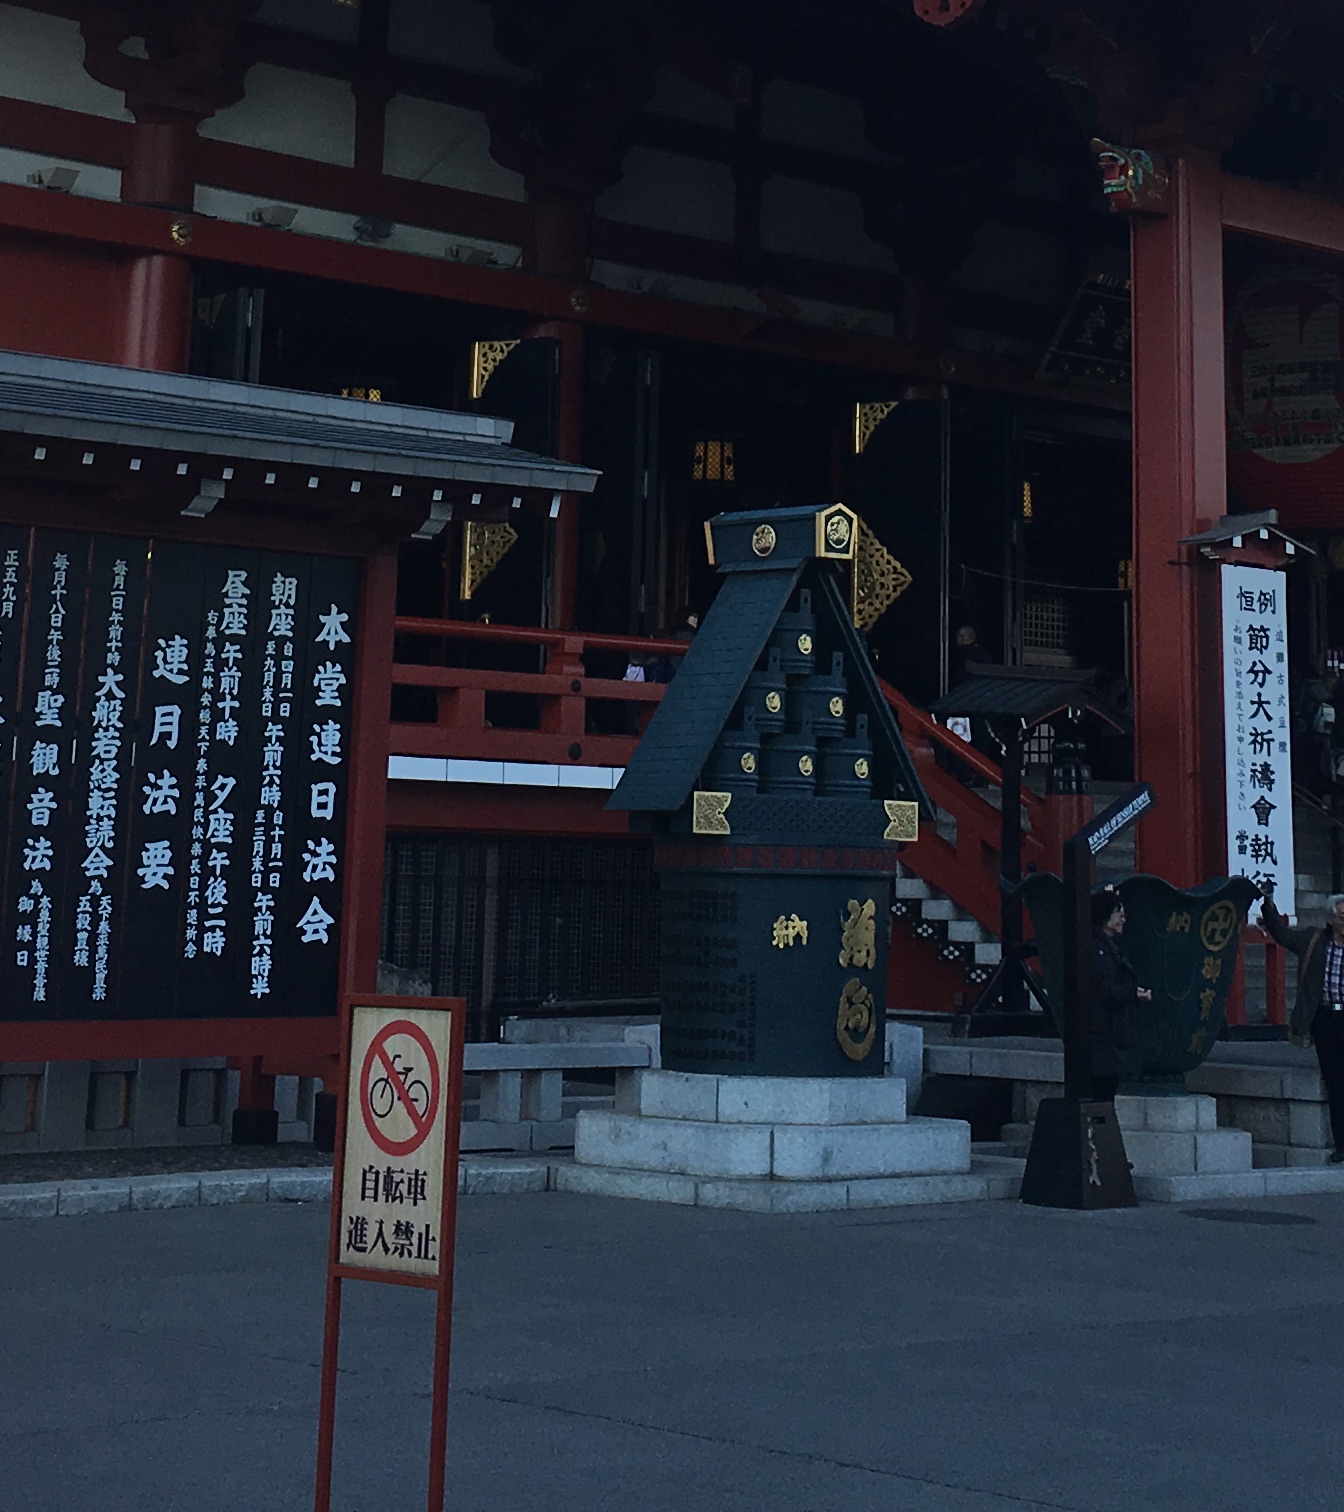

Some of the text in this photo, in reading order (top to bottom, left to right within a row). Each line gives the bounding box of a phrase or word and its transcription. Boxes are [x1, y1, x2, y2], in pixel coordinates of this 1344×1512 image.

[0, 549, 19, 619] 正五九月
[1236, 586, 1276, 615] 恒例
[261, 640, 276, 717] 至九月末日
[279, 641, 294, 717] 自四月一日
[22, 690, 66, 871] 聖観音法
[136, 635, 190, 890] 連月法要
[250, 572, 297, 999] 朝座 午前六時 午前六時半
[296, 602, 352, 945] 本堂連日法会
[251, 810, 266, 887] 至三月末日
[268, 810, 285, 888] 自十月一日
[360, 1164, 428, 1206] 自転車
[346, 1215, 437, 1262] 進入禁止
